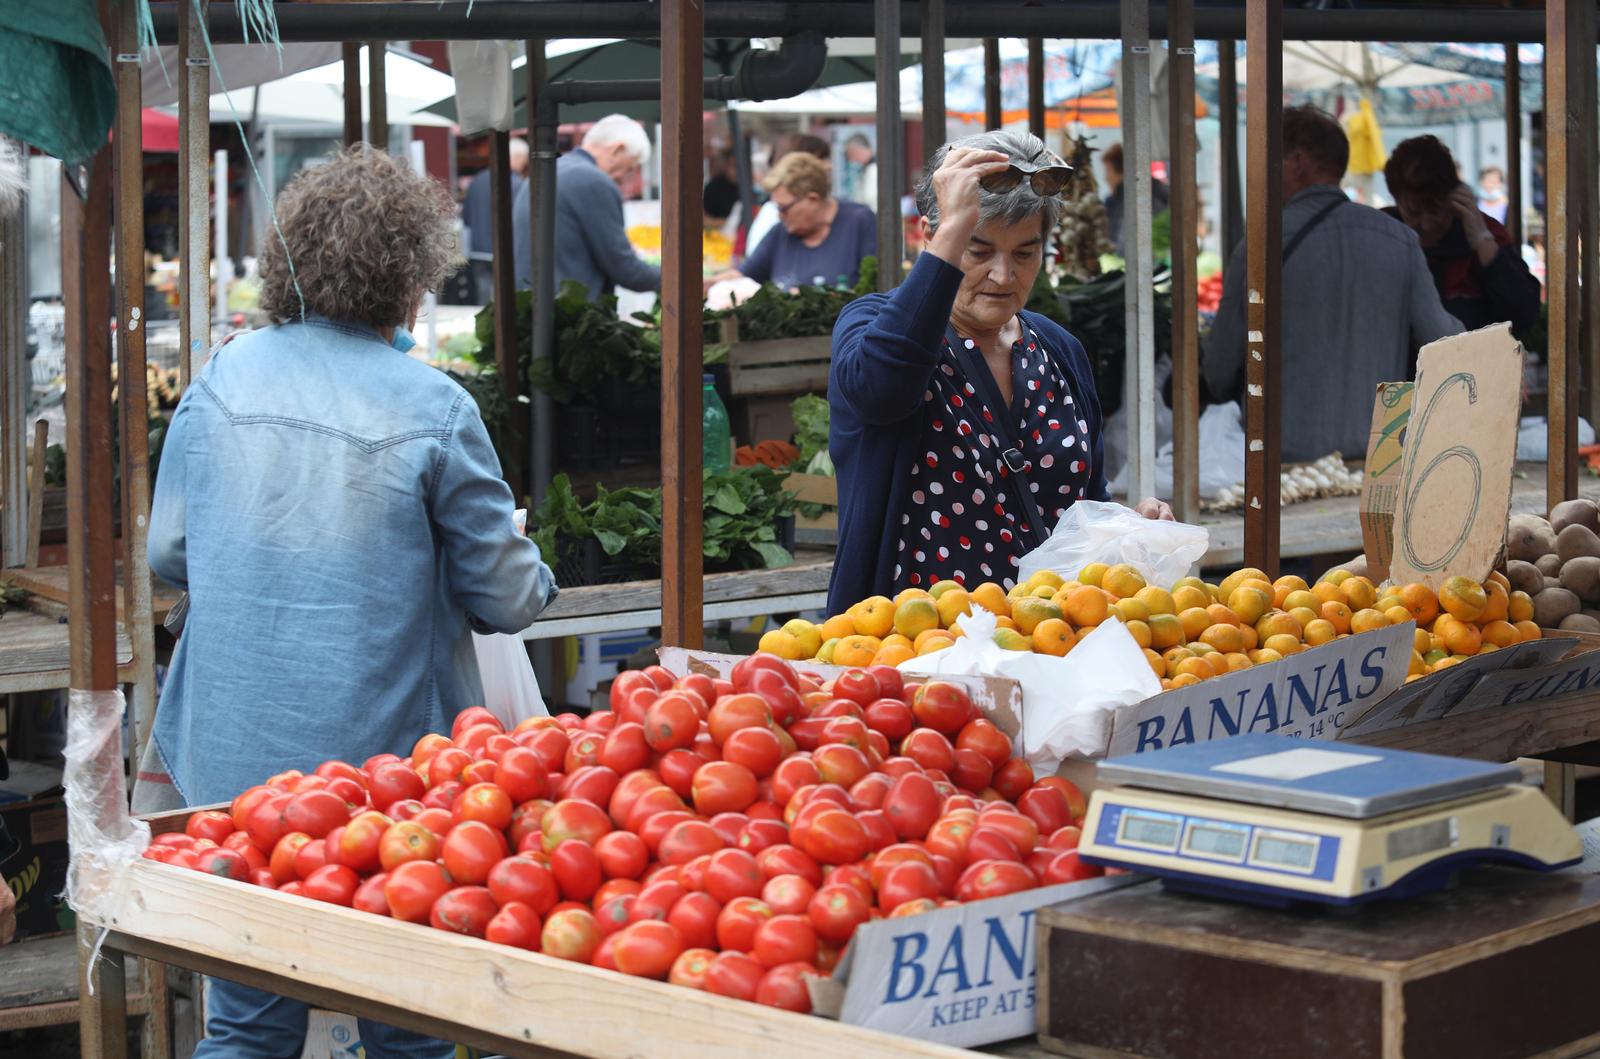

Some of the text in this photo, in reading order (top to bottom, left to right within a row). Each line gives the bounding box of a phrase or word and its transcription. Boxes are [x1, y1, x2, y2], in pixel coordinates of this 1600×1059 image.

[1402, 372, 1482, 572] 6
[1136, 646, 1387, 754] BANANAS
[1309, 719, 1324, 739] 14
[882, 910, 1036, 1005] BAN
[931, 996, 988, 1028] KEEP
[992, 989, 1022, 1016] AT
